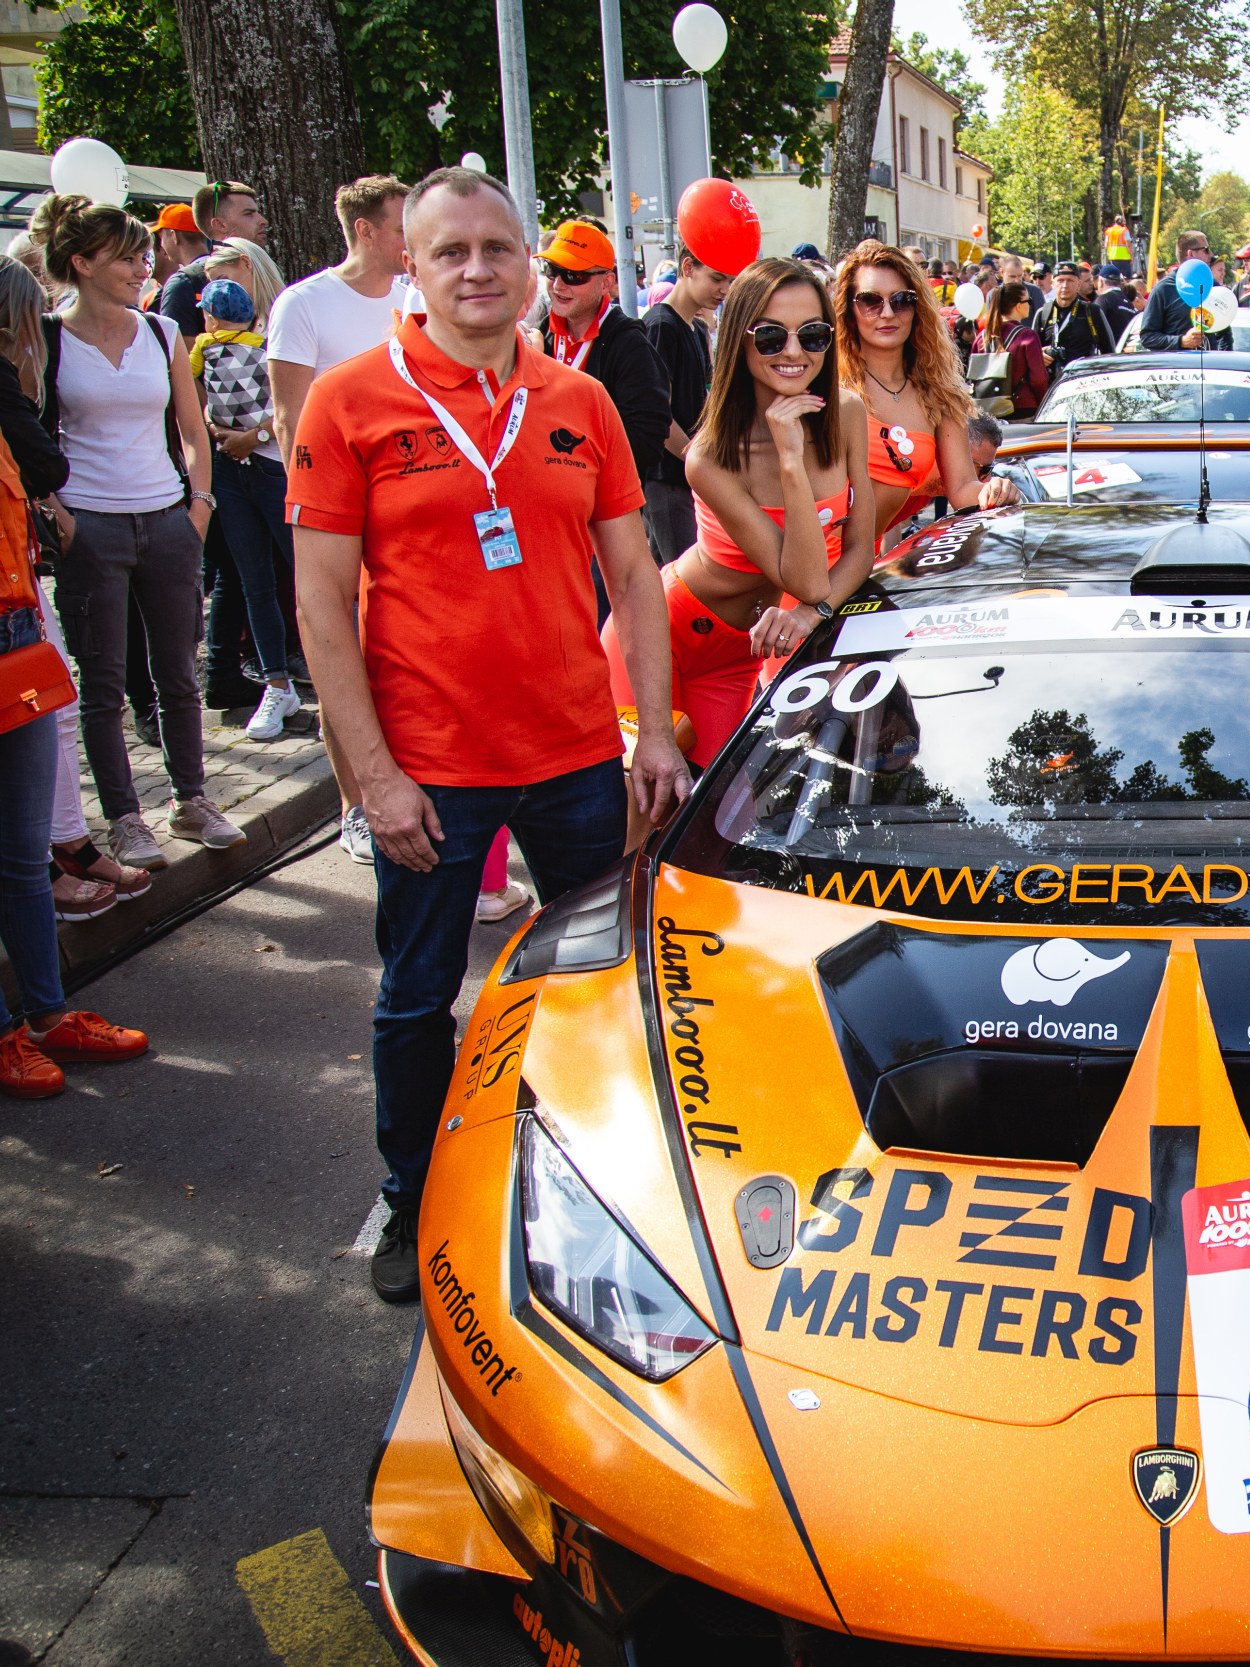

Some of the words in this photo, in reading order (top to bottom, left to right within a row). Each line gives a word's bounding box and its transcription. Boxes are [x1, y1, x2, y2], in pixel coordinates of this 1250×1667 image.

[1145, 372, 1207, 382] AURUM
[544, 456, 562, 465] gera
[563, 456, 587, 470] dovana
[1074, 468, 1108, 486] 4
[916, 608, 1009, 626] AURUM
[770, 660, 899, 713] 60
[481, 990, 538, 1088] UVS
[657, 916, 742, 1158] Lambooo.lt
[965, 1019, 1019, 1043] gera
[1027, 1015, 1118, 1041] dovana
[765, 1267, 1143, 1367] MASTERS
[1139, 1454, 1193, 1468] LAMBORGHINI
